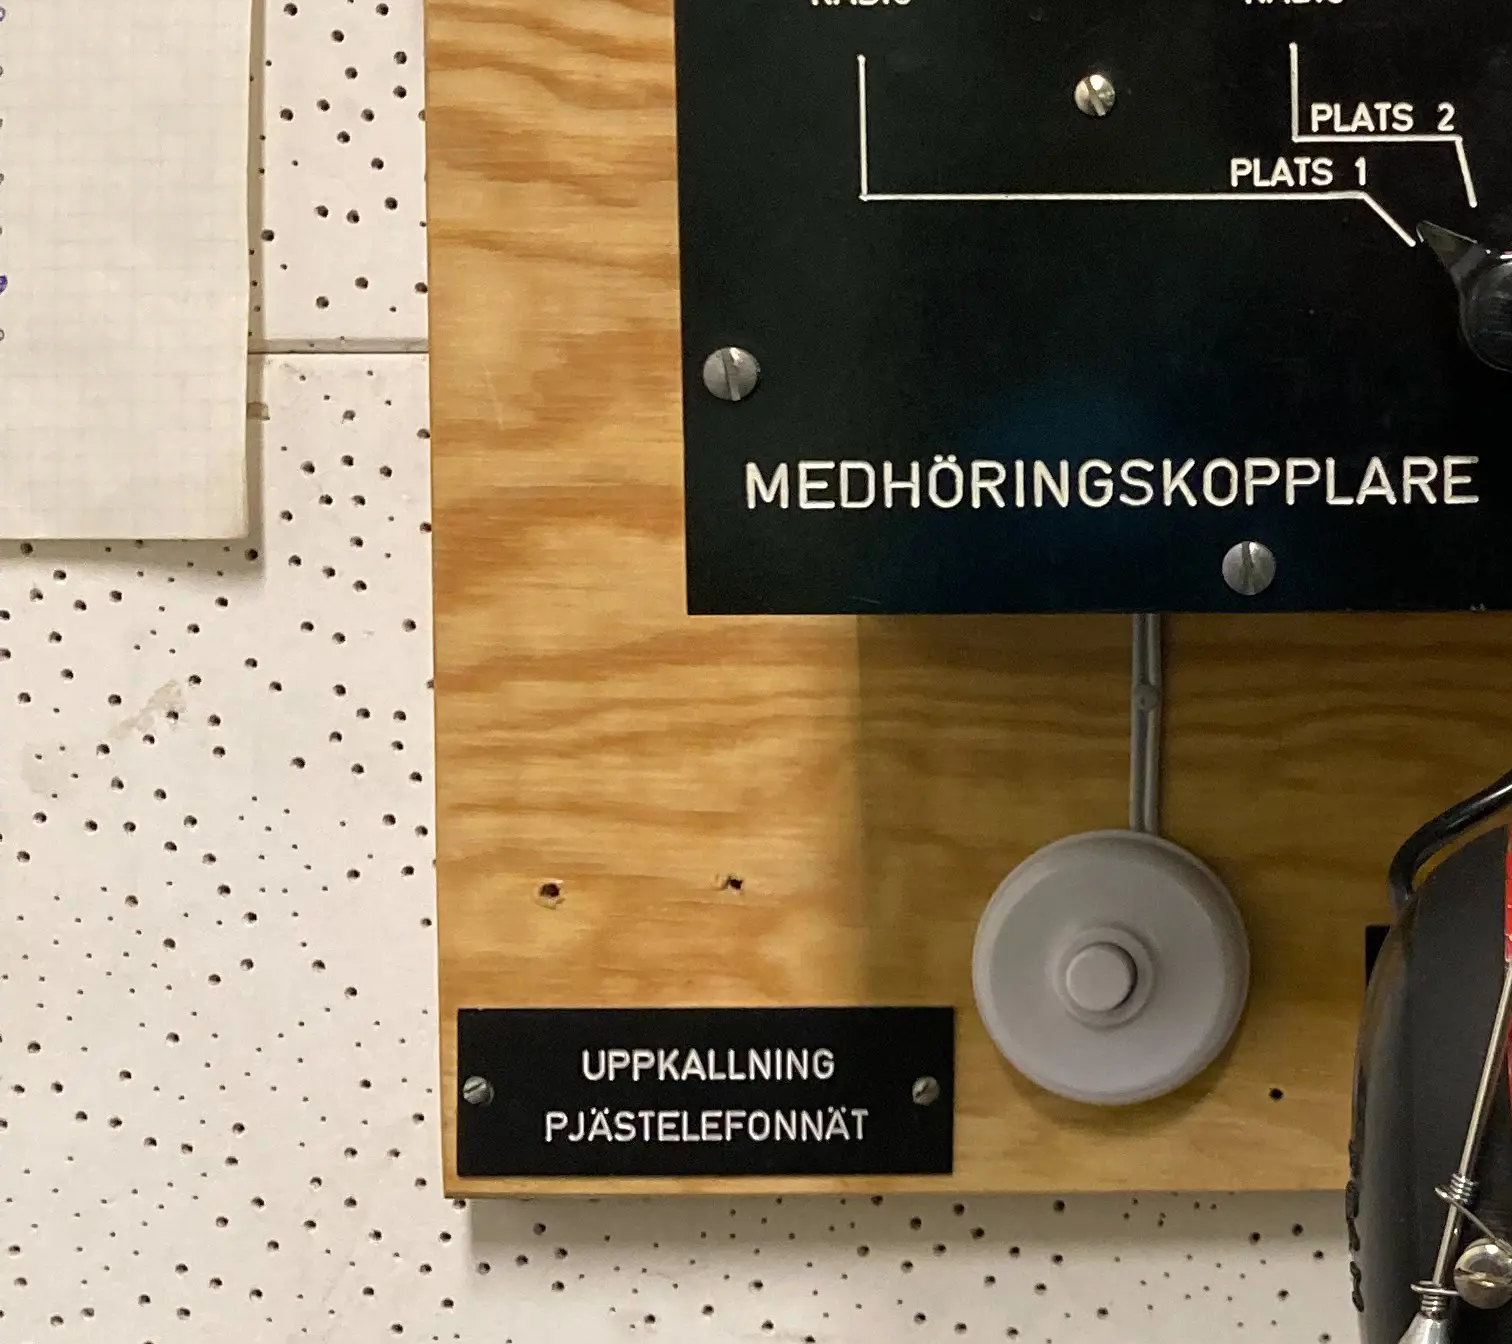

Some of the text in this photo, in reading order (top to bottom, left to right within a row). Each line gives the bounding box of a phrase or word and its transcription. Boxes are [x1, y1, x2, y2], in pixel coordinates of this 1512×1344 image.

[1310, 102, 1456, 134] PLATS 2
[1230, 156, 1367, 189] PLATS 1
[745, 454, 1481, 511] MEDHÖRINGSKOPPLARE
[581, 1047, 836, 1081] UPPKALLNING
[544, 1105, 870, 1143] PJÄSTELEFONNÄT
